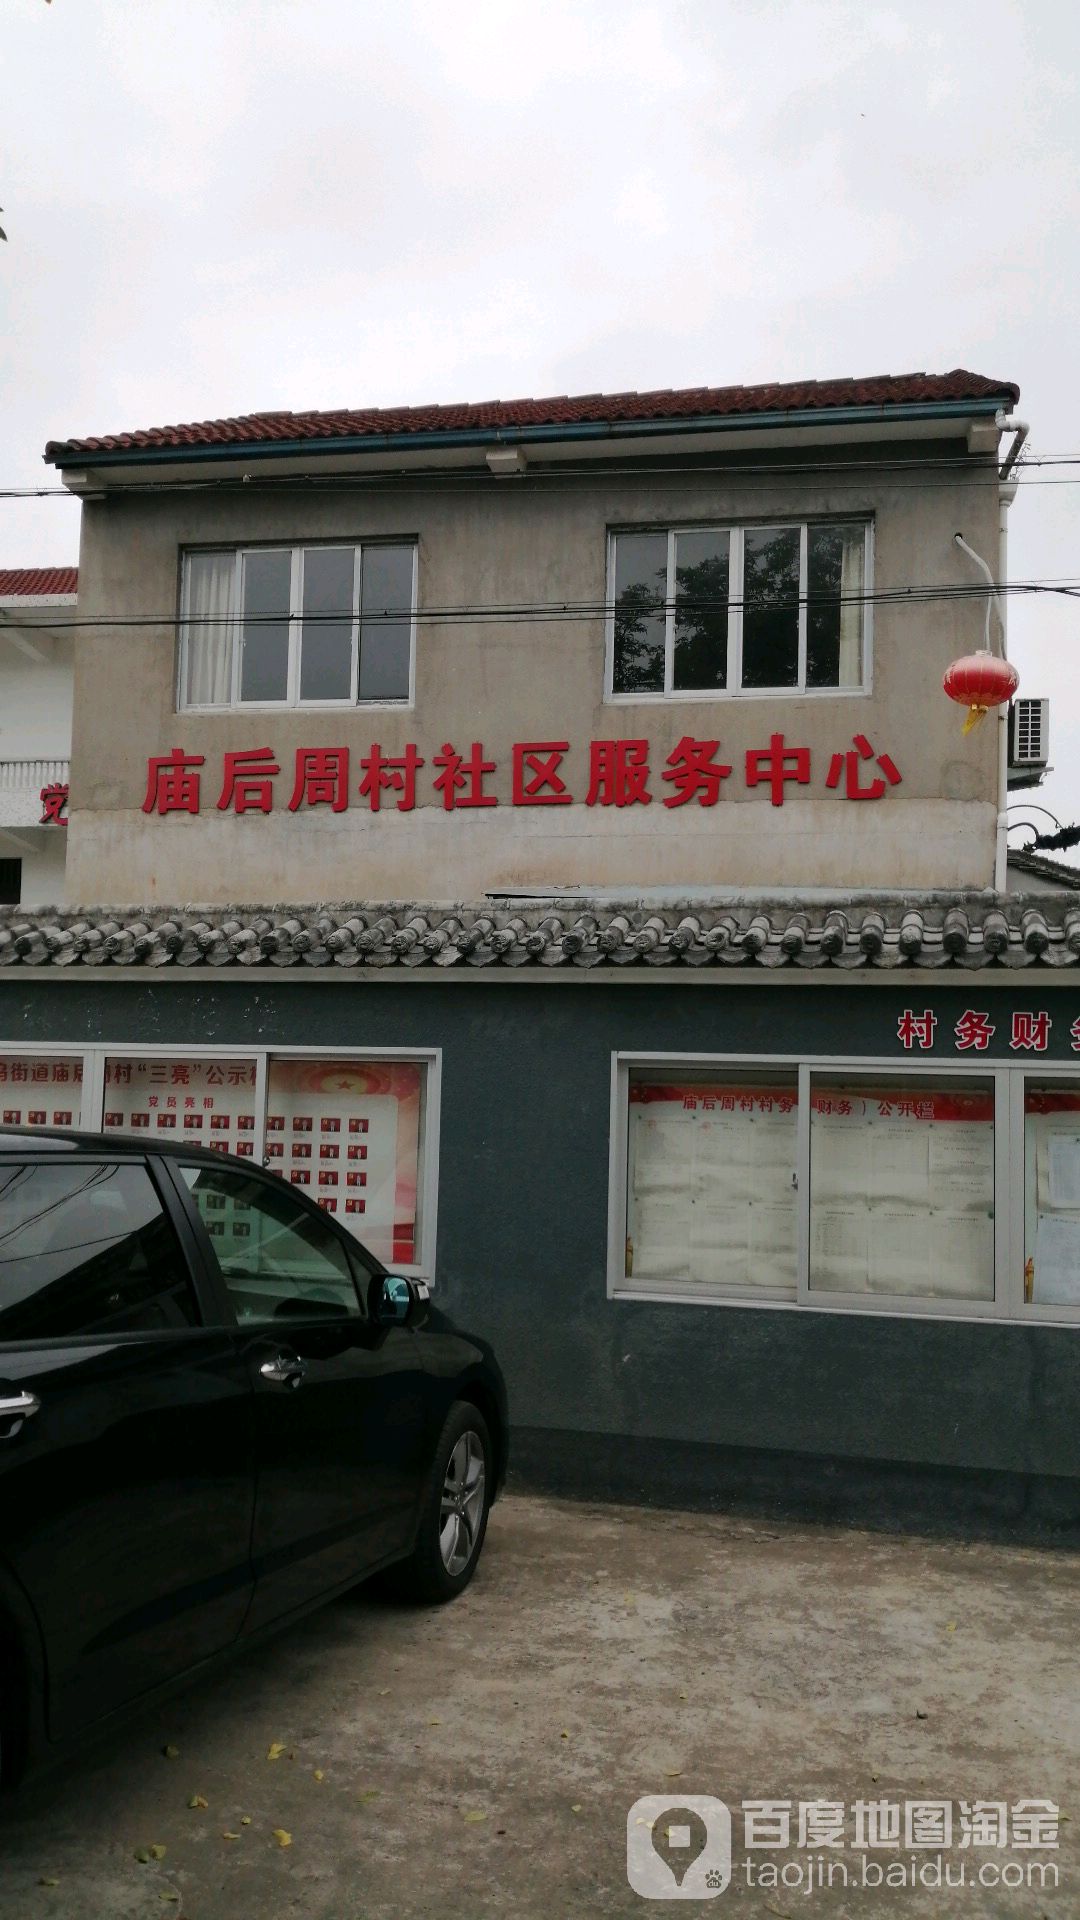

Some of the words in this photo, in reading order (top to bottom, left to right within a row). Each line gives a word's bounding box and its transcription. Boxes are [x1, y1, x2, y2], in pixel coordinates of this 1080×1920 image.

[142, 732, 902, 815] 庙后周村社区服务中心
[897, 1009, 1080, 1051] 村务财
[148, 1096, 214, 1109] 党员亮相
